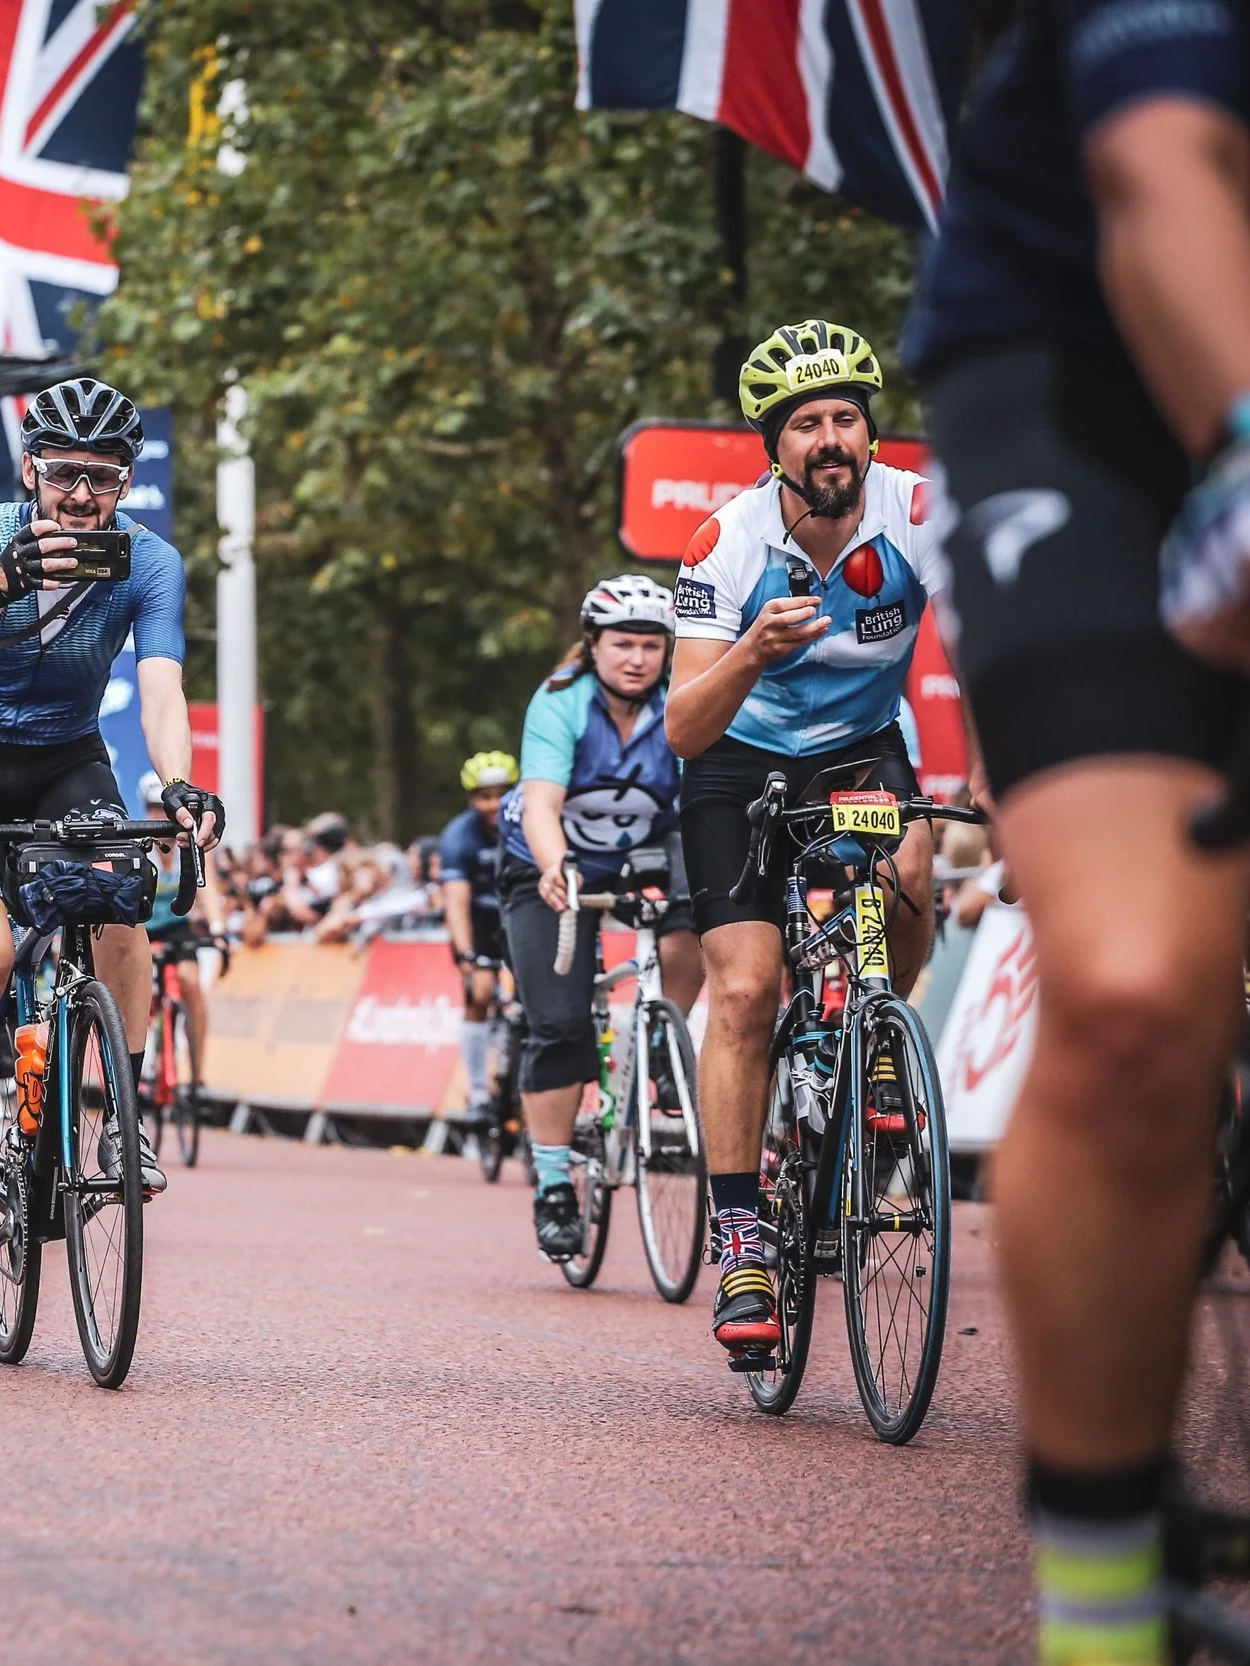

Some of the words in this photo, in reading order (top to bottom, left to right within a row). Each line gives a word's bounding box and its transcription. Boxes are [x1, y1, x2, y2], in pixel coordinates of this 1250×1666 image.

[796, 359, 840, 384] 24040
[861, 614, 902, 634] Lung
[865, 607, 901, 625] British
[837, 812, 846, 827] B
[852, 810, 895, 830] 24040
[862, 915, 885, 967] 24040
